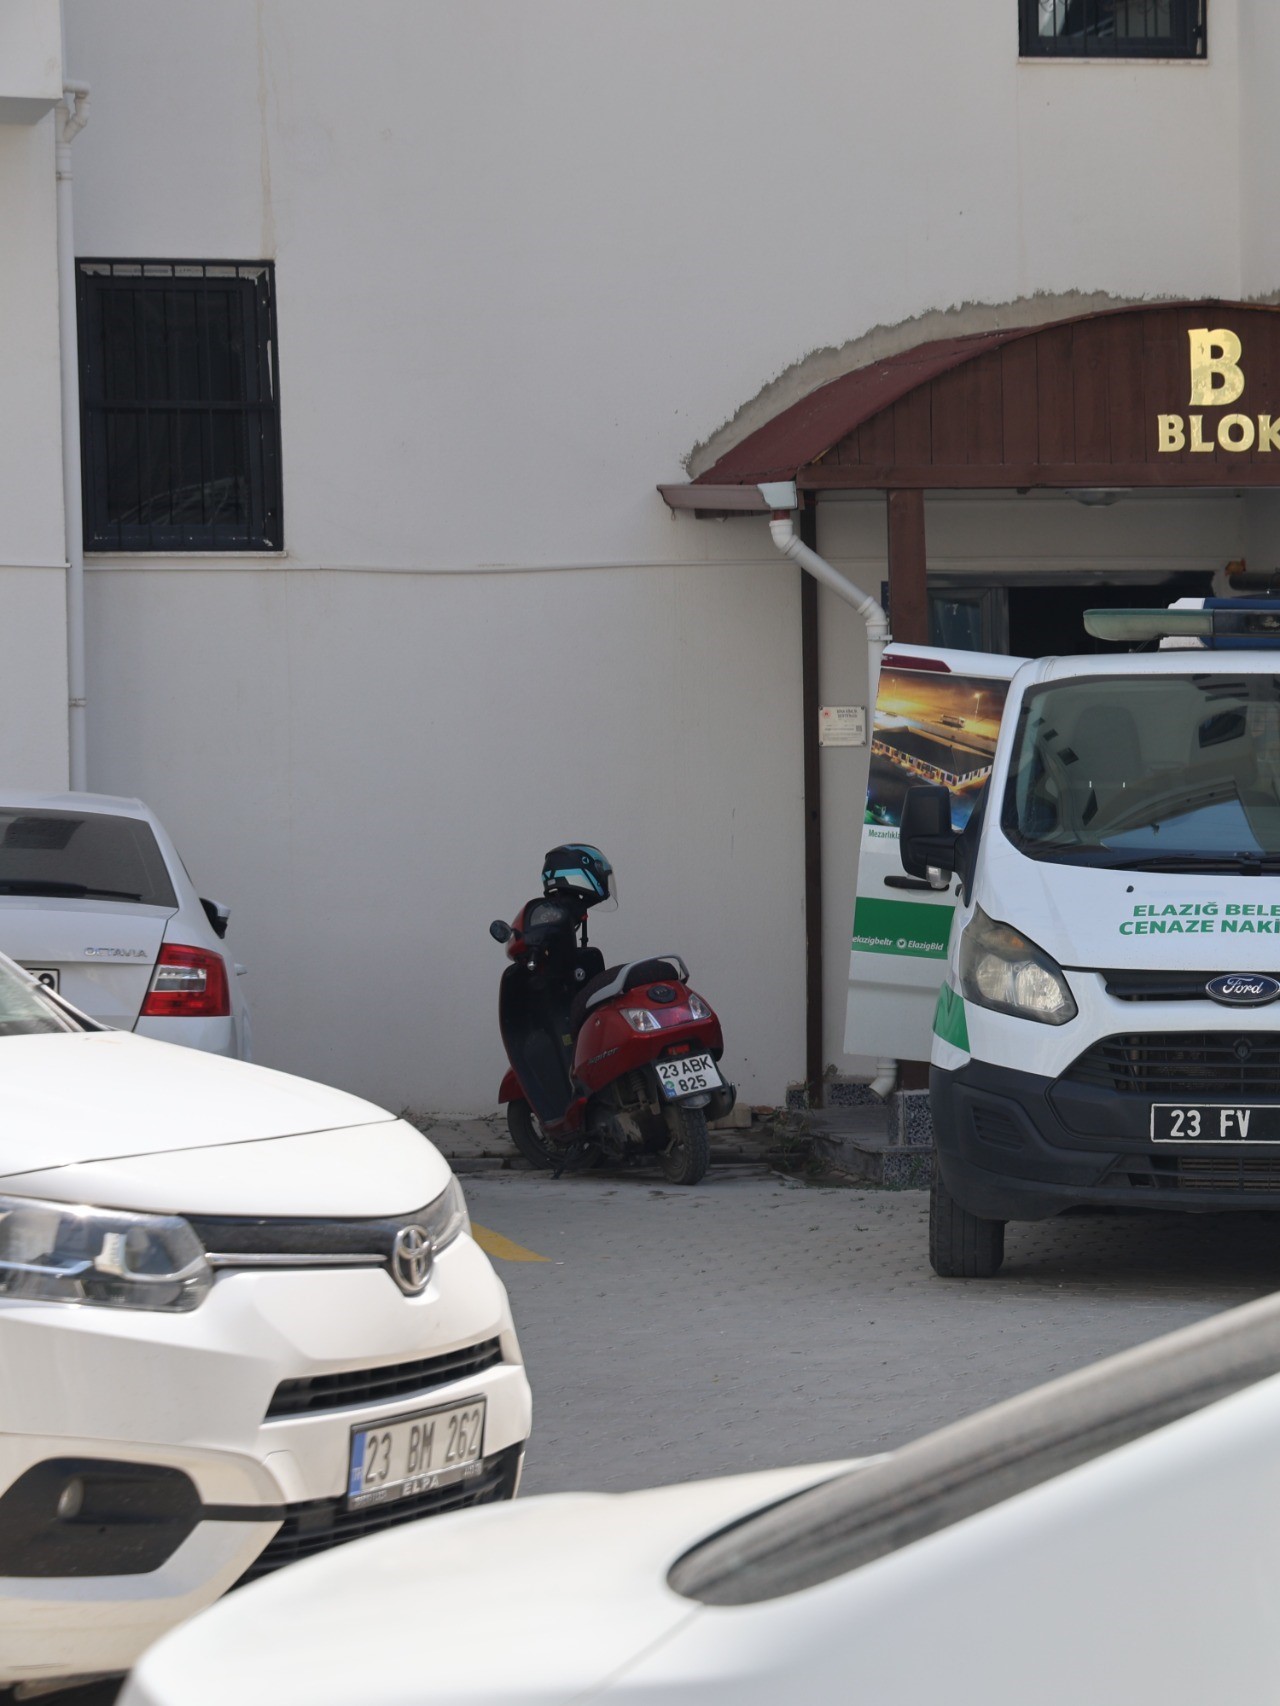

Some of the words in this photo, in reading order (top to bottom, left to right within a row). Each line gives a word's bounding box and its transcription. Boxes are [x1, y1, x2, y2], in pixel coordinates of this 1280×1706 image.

[1188, 328, 1245, 406] B
[1133, 902, 1218, 917] ELAZIĞ
[1119, 919, 1214, 936] CENAZE
[1222, 977, 1263, 994] Ford
[660, 1064, 679, 1080] 23
[682, 1056, 713, 1075] ABK
[678, 1075, 707, 1092] 825
[1170, 1109, 1201, 1137] 23
[1220, 1109, 1250, 1137] FV
[365, 1432, 392, 1484] 23
[407, 1421, 435, 1474] BM
[445, 1409, 481, 1463] 262
[402, 1476, 439, 1496] ELPA
